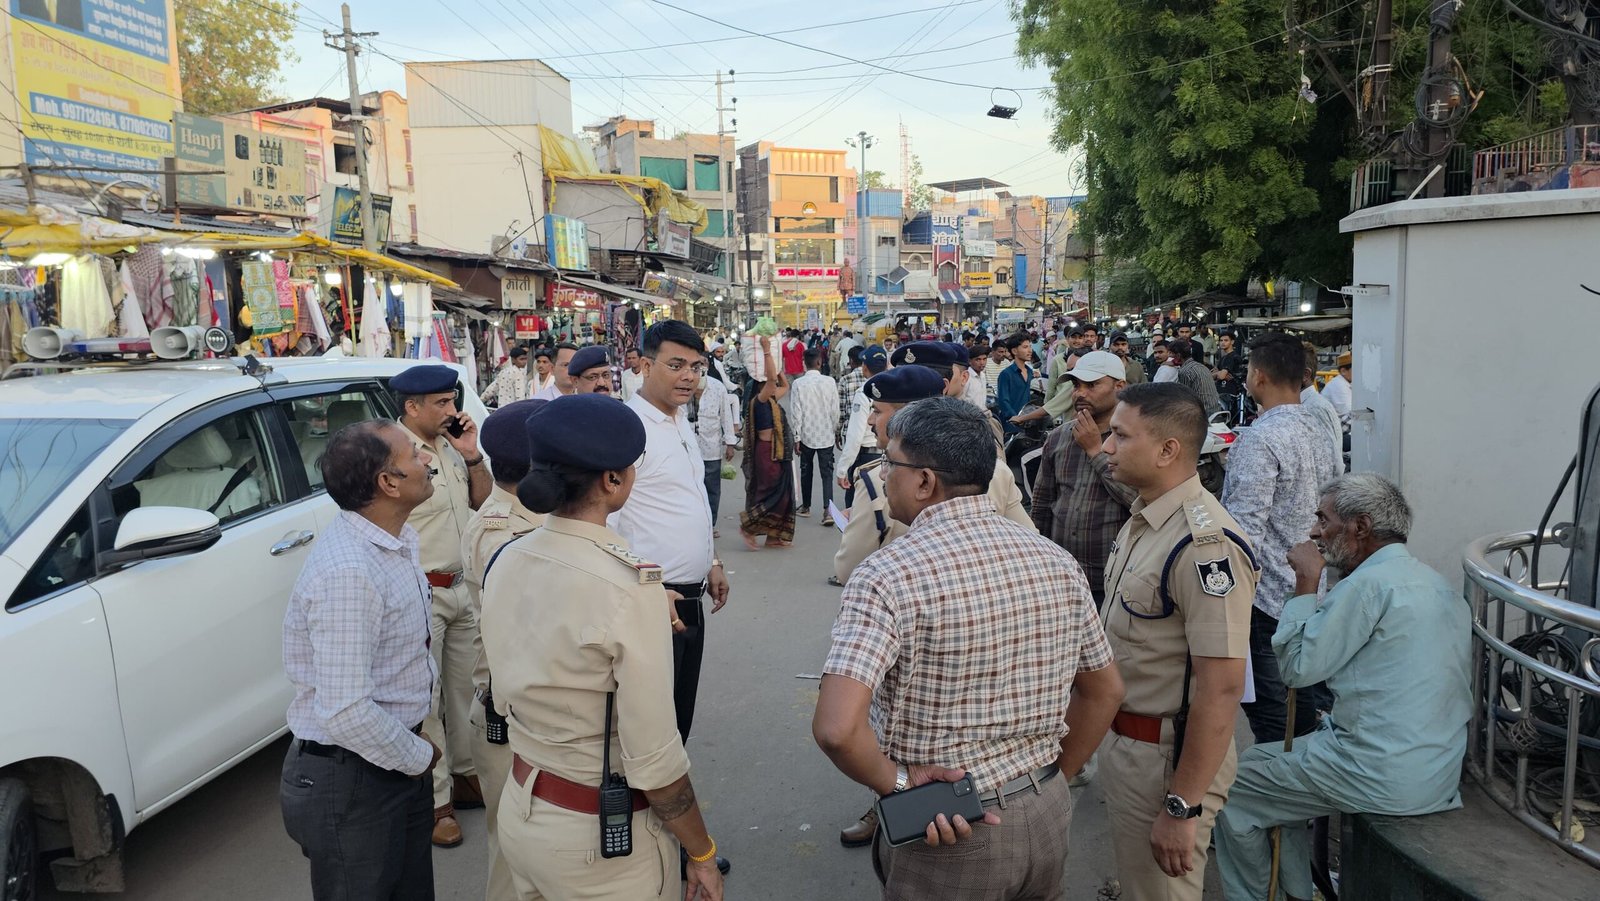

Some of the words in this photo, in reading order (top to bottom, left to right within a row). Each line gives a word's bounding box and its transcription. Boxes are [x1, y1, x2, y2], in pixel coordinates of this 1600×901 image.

[34, 95, 62, 116] Mob.
[62, 127, 83, 141] सुबह
[181, 127, 222, 150] Hanfi
[931, 230, 960, 246] रेडियो
[506, 276, 531, 291] मोती
